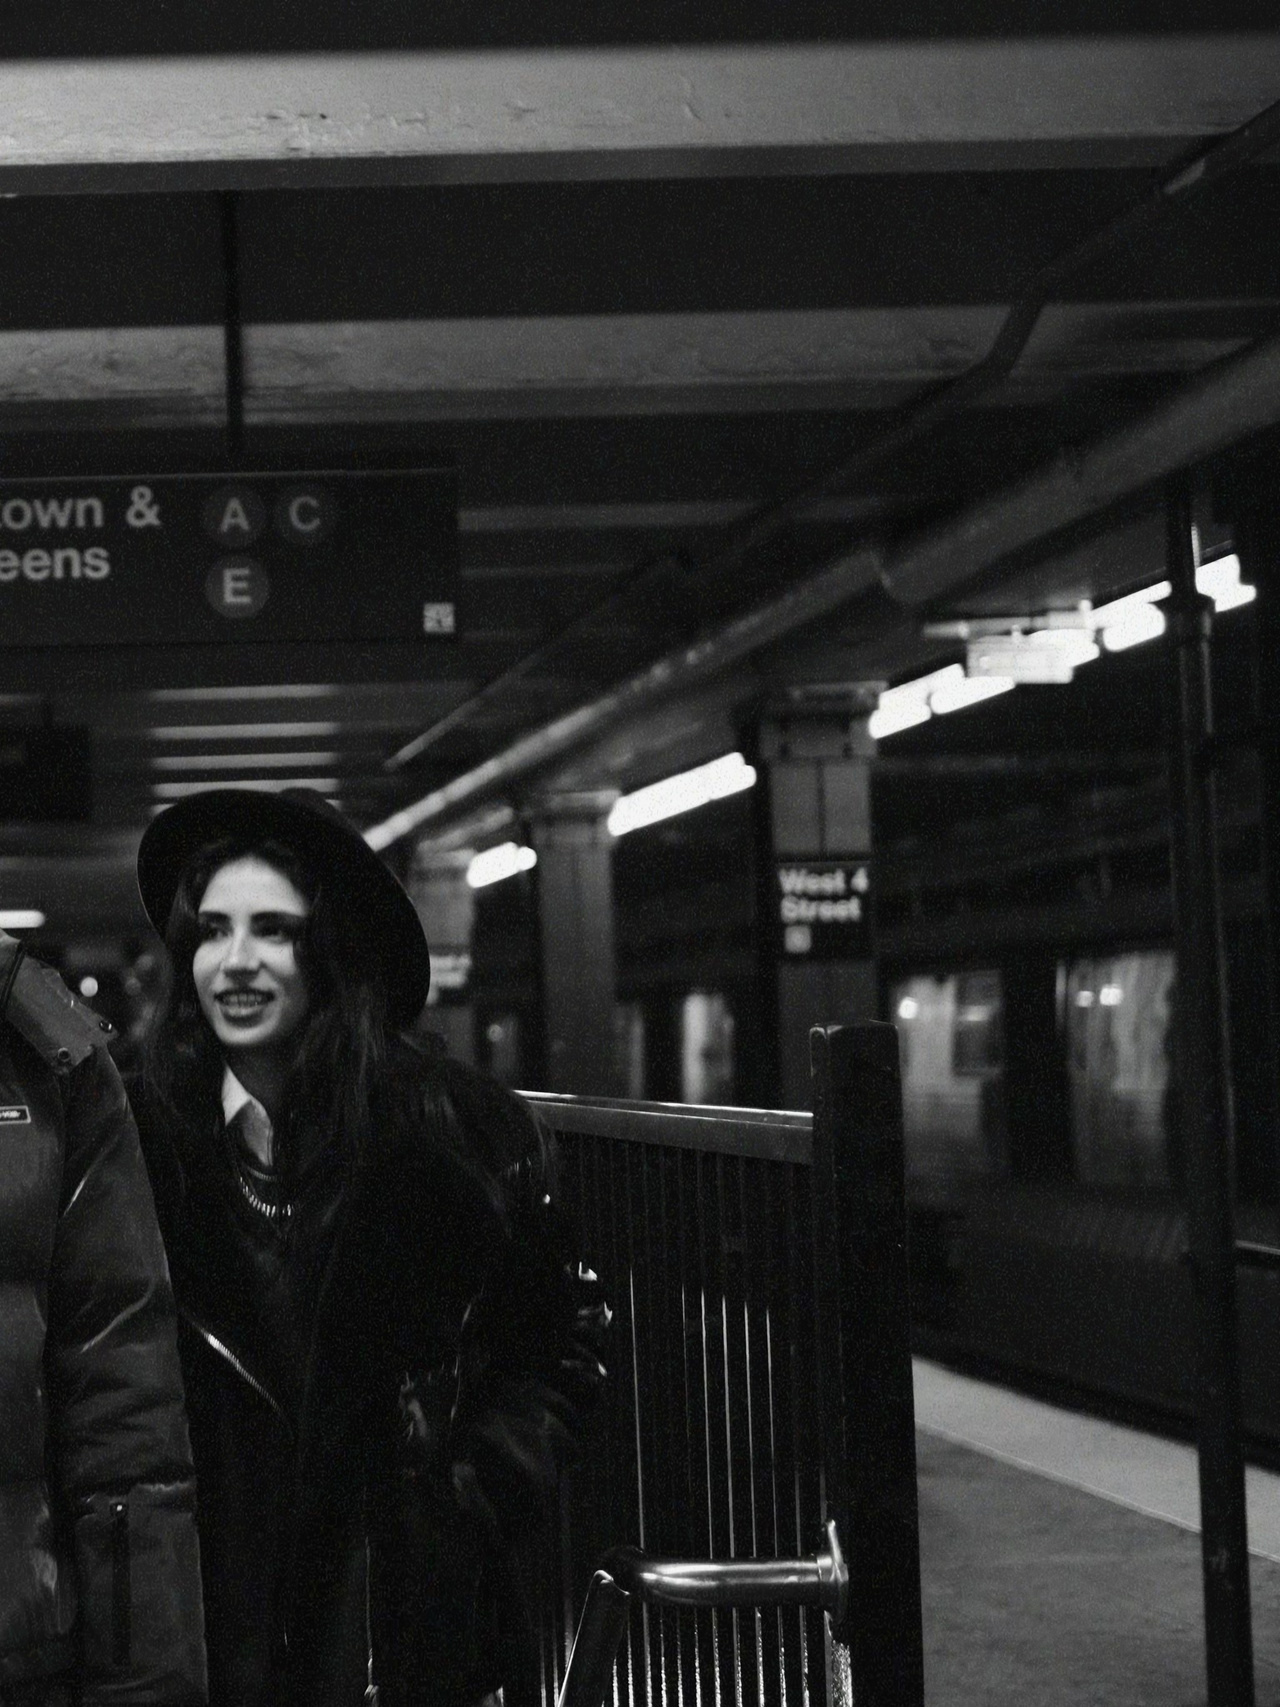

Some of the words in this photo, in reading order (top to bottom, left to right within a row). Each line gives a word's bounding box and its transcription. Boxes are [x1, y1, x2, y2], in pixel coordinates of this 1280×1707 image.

[124, 484, 162, 529] &
[220, 498, 252, 532] A
[288, 496, 320, 531] C
[222, 568, 252, 604] E
[778, 868, 846, 896] West
[850, 867, 869, 893] 4
[781, 895, 862, 924] Street
